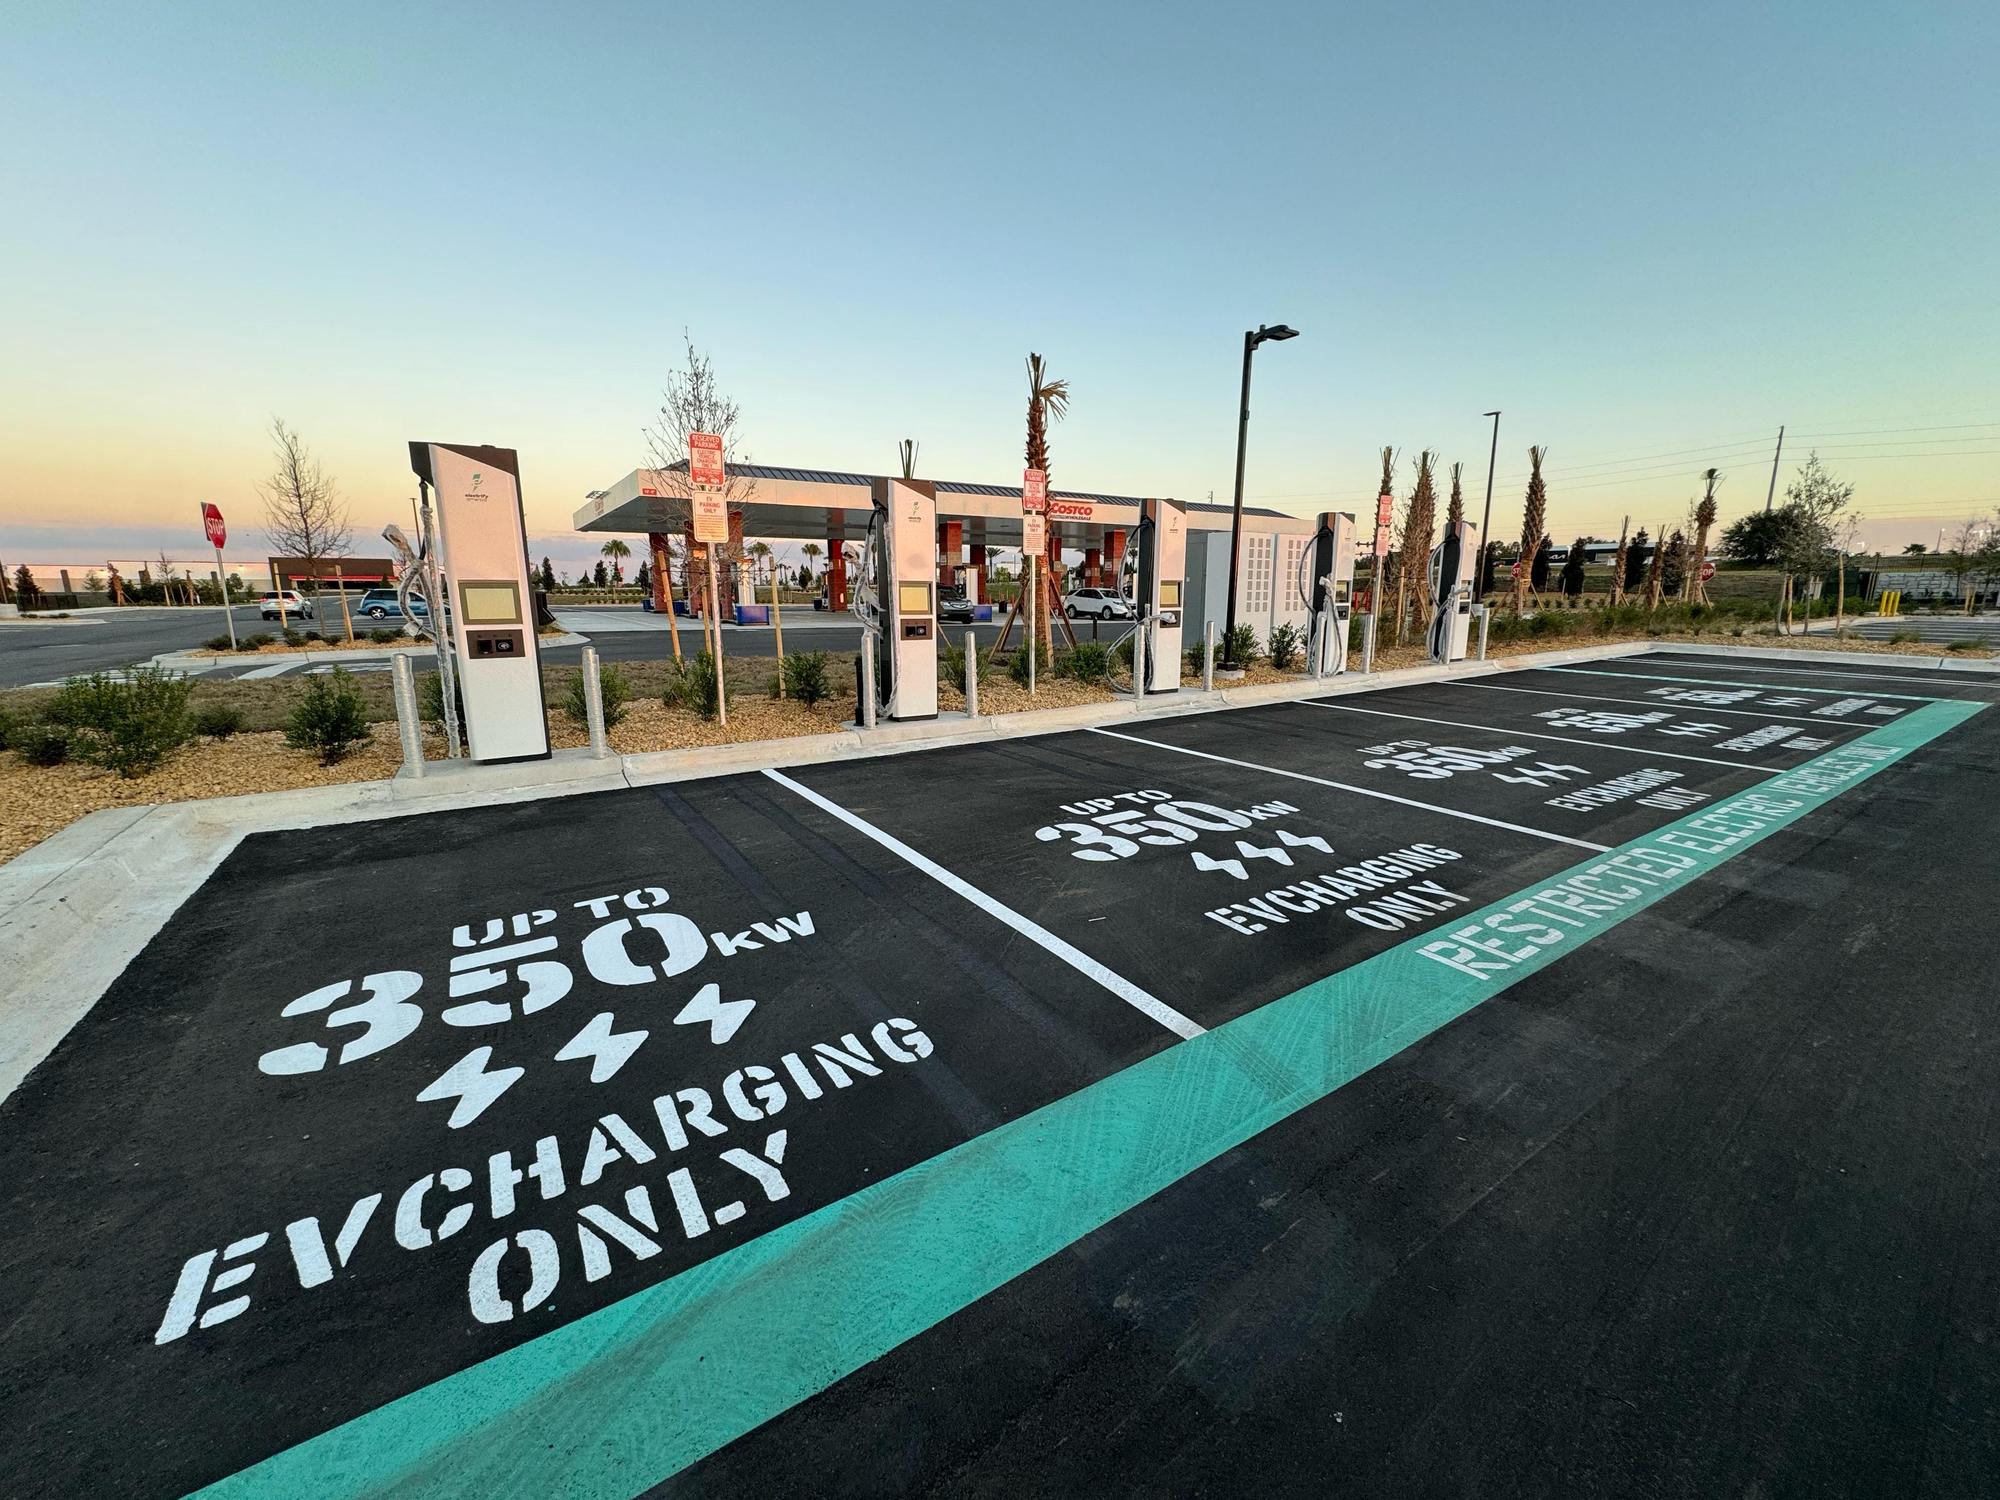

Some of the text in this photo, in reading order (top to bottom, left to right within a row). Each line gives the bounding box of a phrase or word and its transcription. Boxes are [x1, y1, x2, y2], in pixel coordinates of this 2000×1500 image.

[695, 441, 719, 449] PARKING
[1051, 503, 1093, 516] COSTCO
[207, 517, 224, 535] STOP
[1059, 789, 1173, 815] UP TO
[1635, 786, 1712, 810] ONLY
[1416, 741, 1902, 981] RESTRICTED ELECTRIC VEHICLES ONLY
[453, 887, 670, 947] UP TO
[1345, 880, 1470, 931] ONLY
[468, 1129, 792, 1324] ONLY
